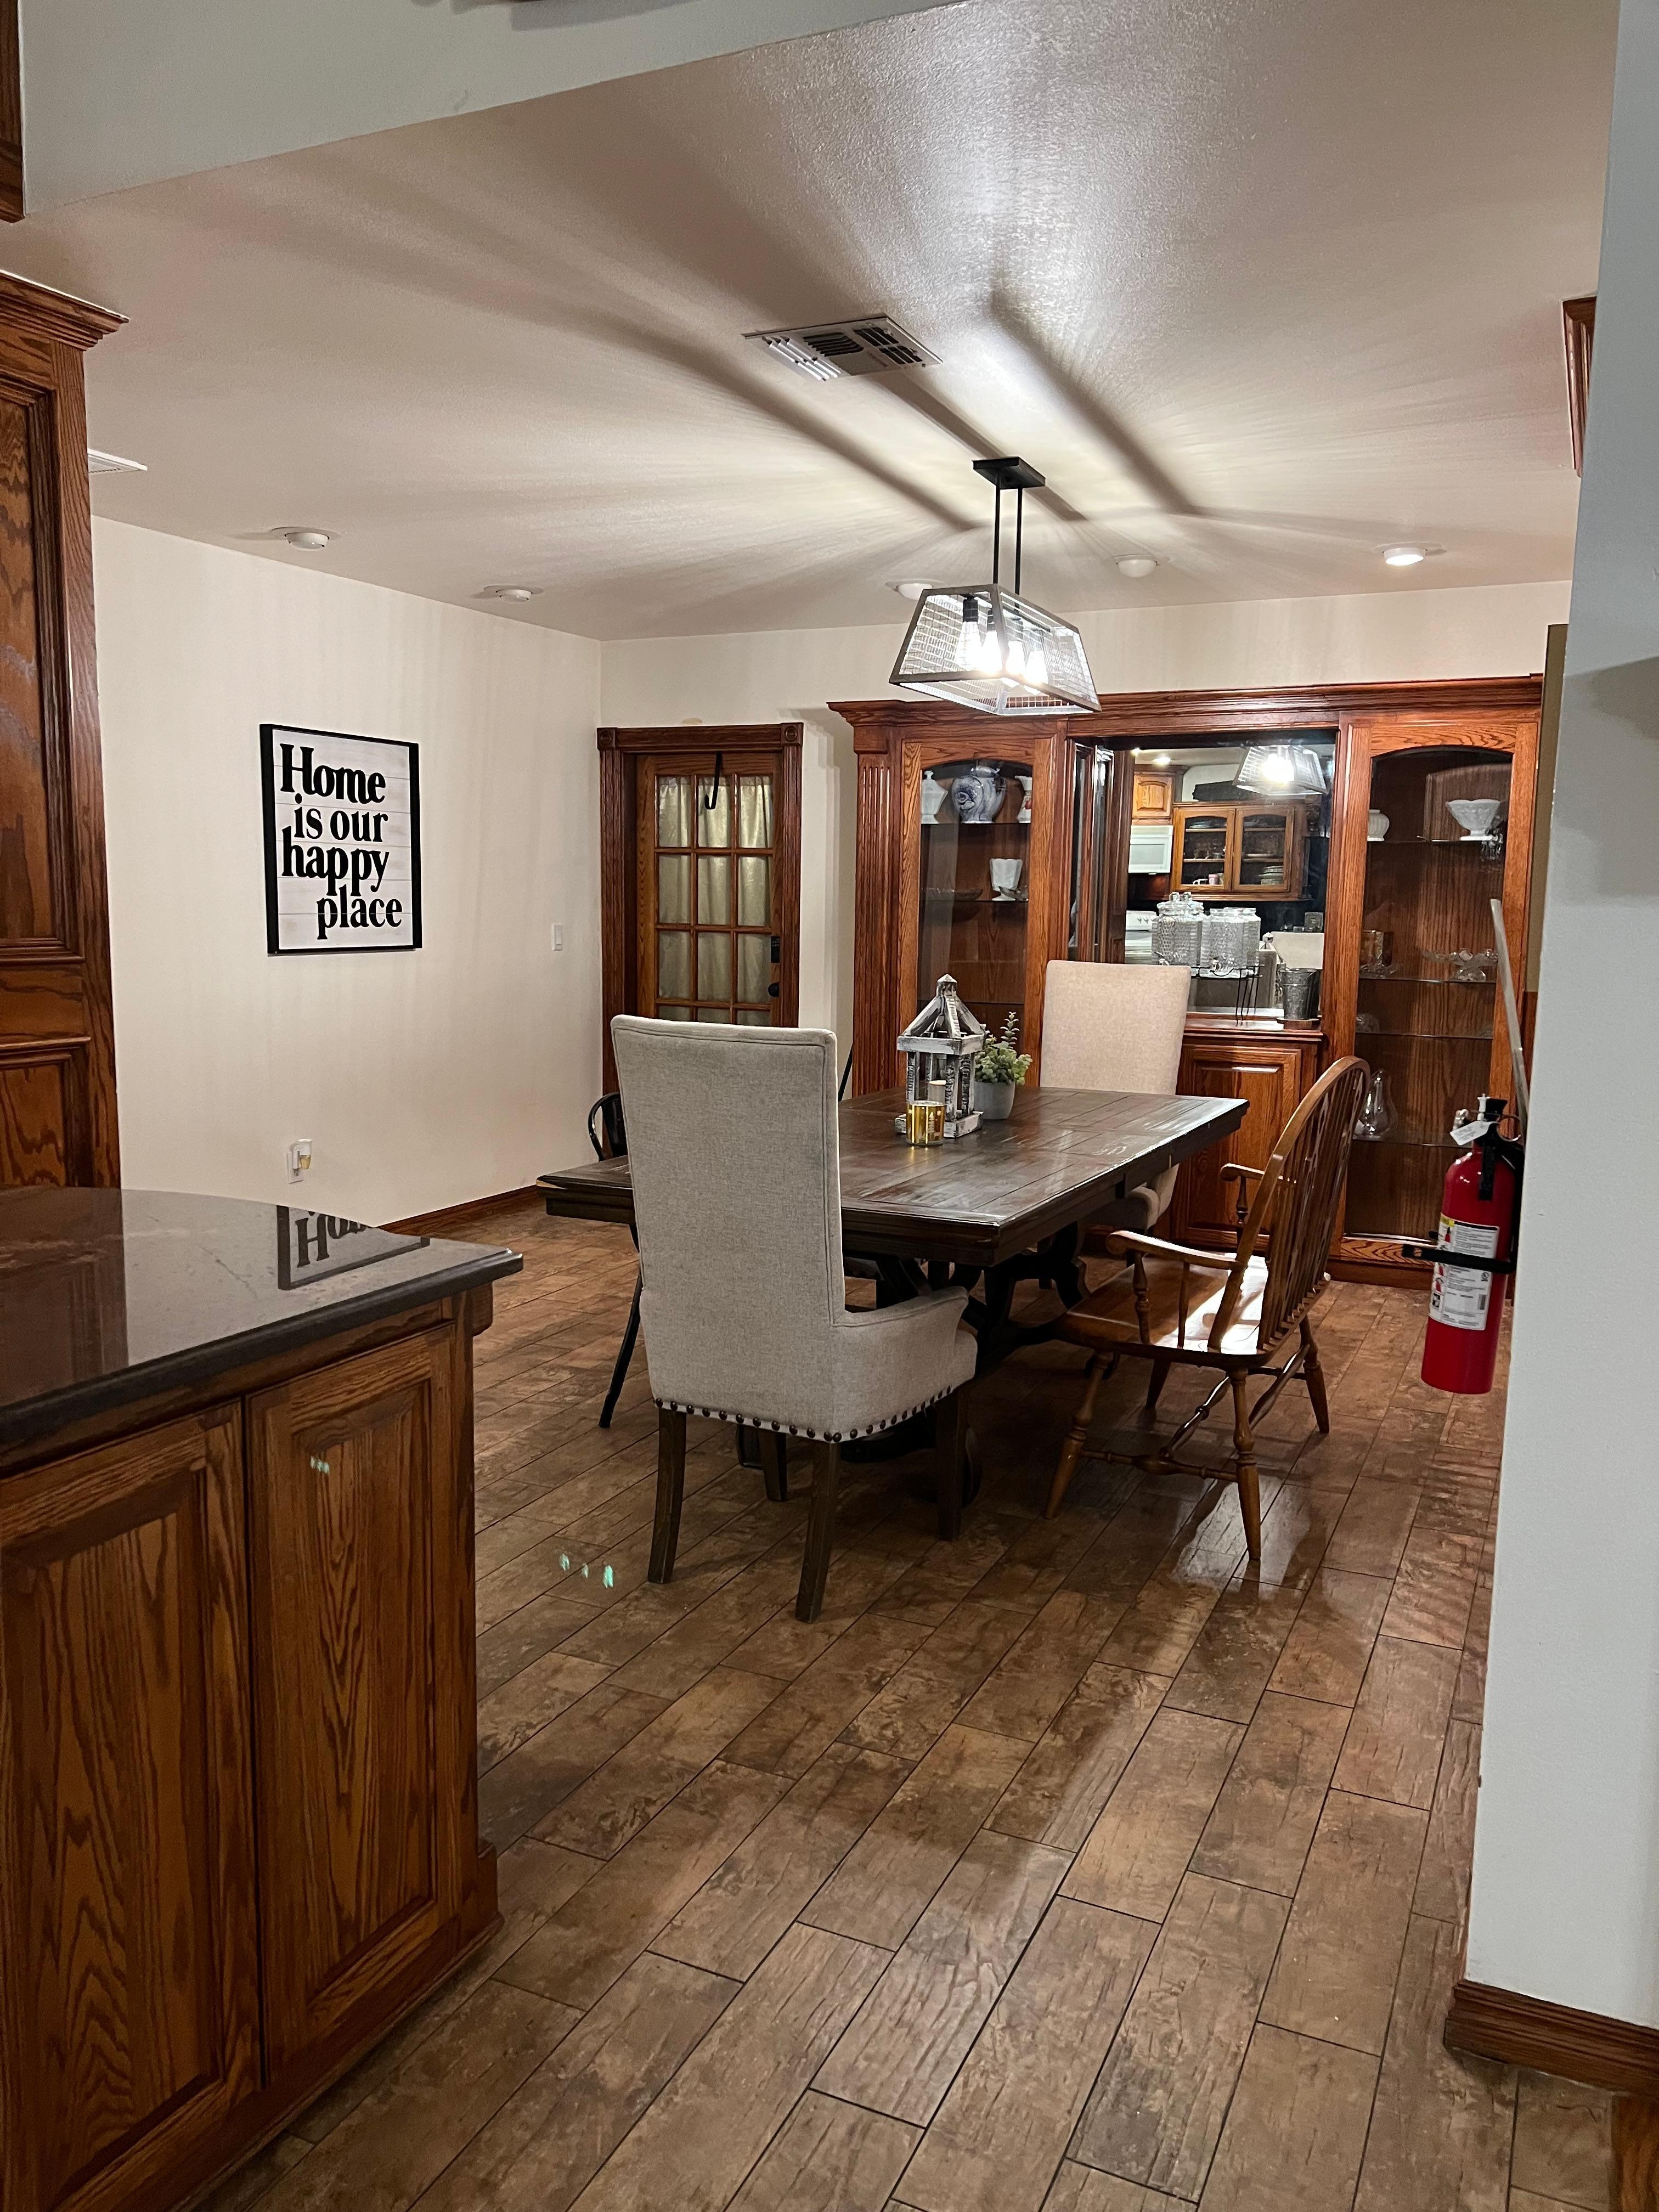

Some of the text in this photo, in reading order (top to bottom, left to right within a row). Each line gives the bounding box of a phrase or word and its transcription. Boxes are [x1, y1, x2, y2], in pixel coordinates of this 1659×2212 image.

[280, 743, 386, 804] Home
[294, 793, 388, 842] is our
[281, 826, 390, 896] happy
[316, 884, 403, 940] place
